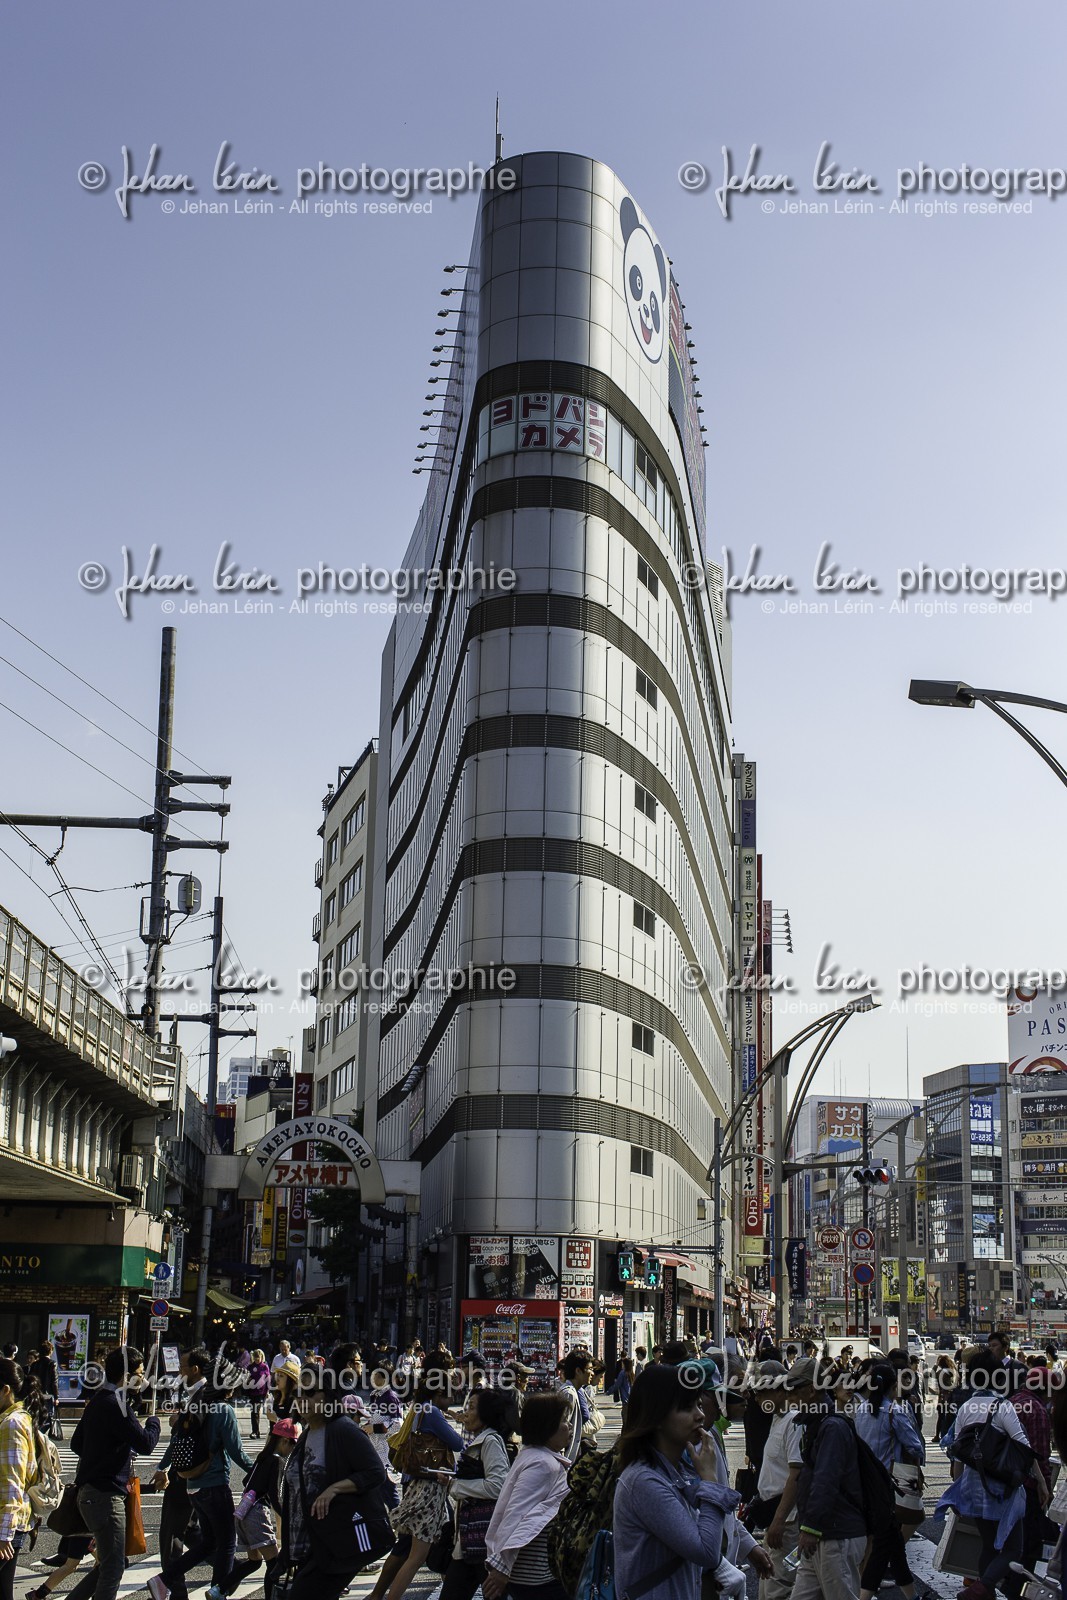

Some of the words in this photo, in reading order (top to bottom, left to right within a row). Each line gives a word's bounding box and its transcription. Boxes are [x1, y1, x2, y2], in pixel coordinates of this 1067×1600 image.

[493, 395, 604, 427] ヨドバシ
[521, 424, 603, 457] カメラ
[745, 764, 753, 799] タツミビル
[745, 902, 753, 930] ヤマト
[1027, 1017, 1066, 1037] PAS
[256, 1122, 372, 1169] AMEYAYOKOCHO
[274, 1164, 353, 1186] アメヤ横丁
[279, 1214, 287, 1248] OUTLET
[470, 1237, 508, 1245] ヨドバシカメラ
[513, 1238, 556, 1246] でお買い物なら
[822, 1234, 840, 1244] 消火栓
[2, 1256, 41, 1268] NTO
[822, 1254, 845, 1264] 上野医院
[539, 1274, 556, 1284] VISA
[958, 1273, 966, 1308] TSUTAYA
[664, 1269, 674, 1319] ヨドバシカメラ
